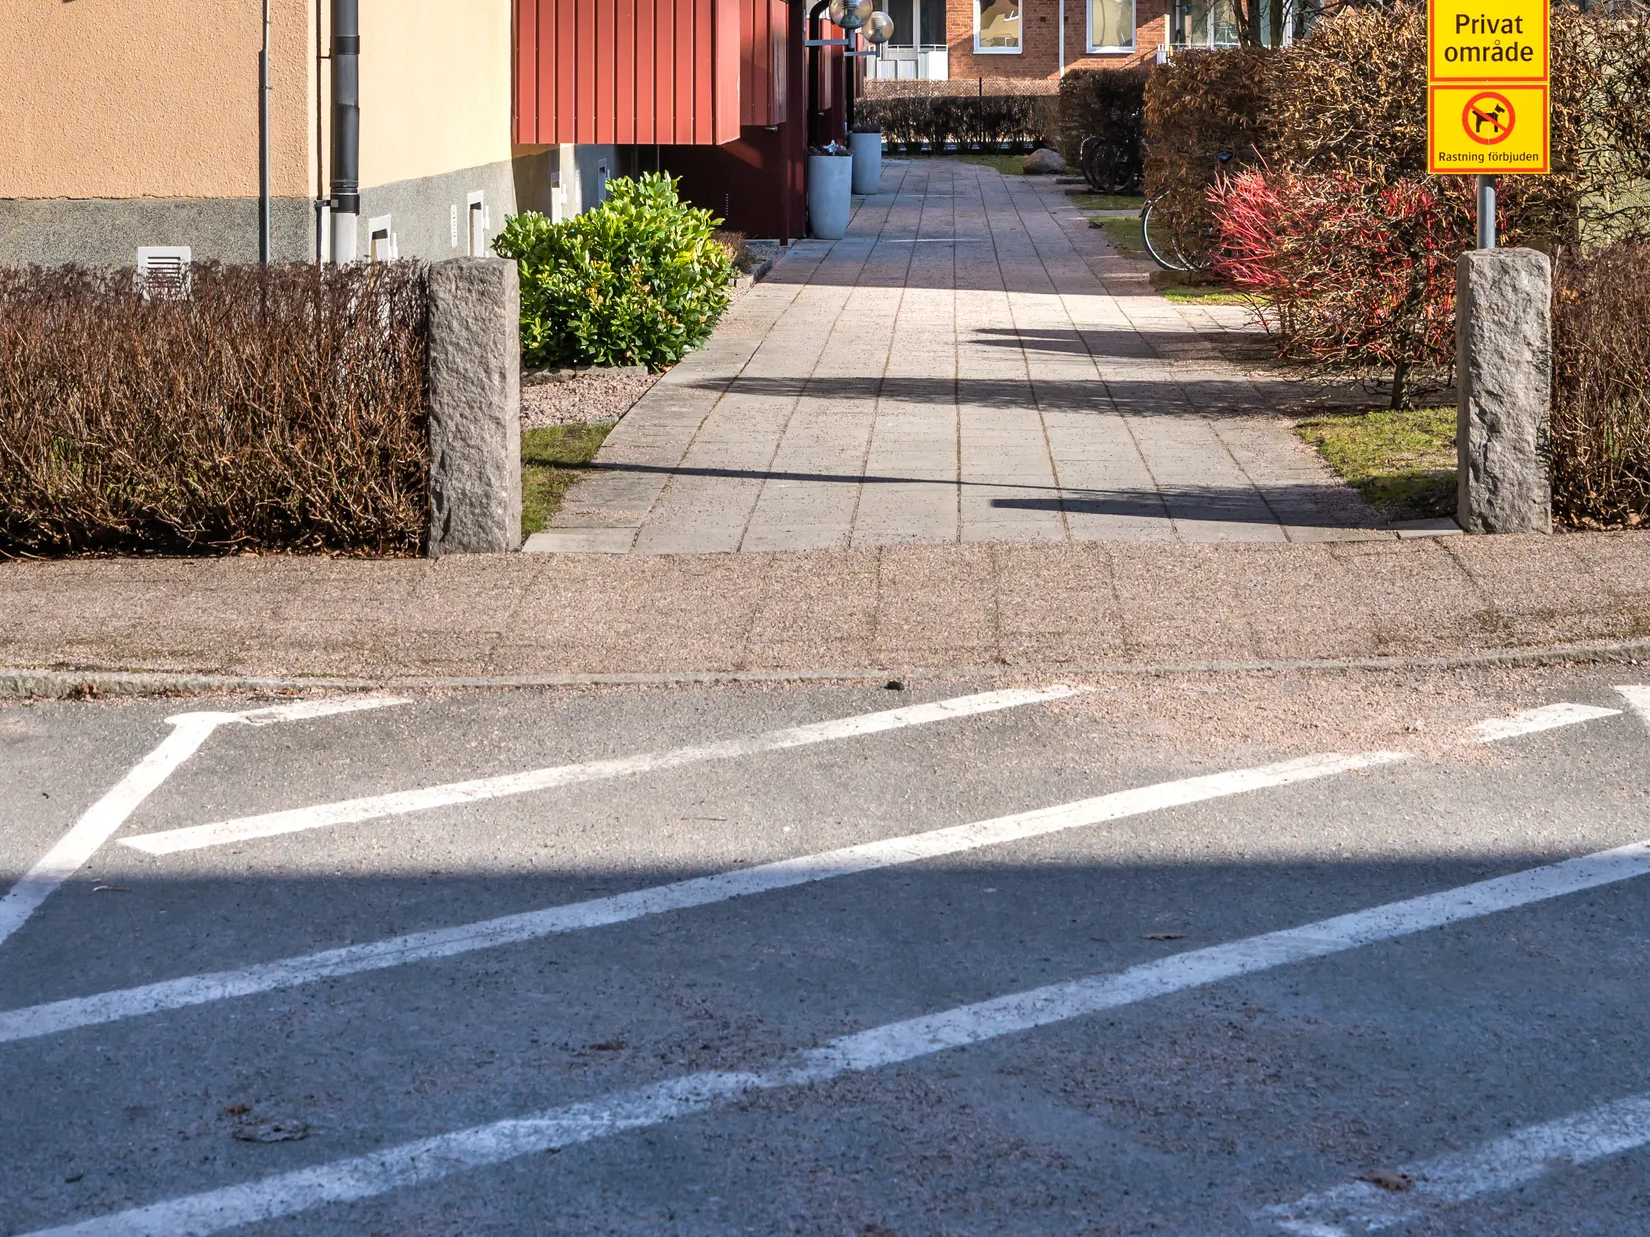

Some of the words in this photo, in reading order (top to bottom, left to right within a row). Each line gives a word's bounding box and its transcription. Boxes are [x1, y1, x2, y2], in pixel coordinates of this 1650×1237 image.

[1455, 14, 1523, 34] Privat
[1444, 40, 1534, 62] område
[1438, 152, 1485, 163] Rastning
[1487, 152, 1539, 163] förbjuden
